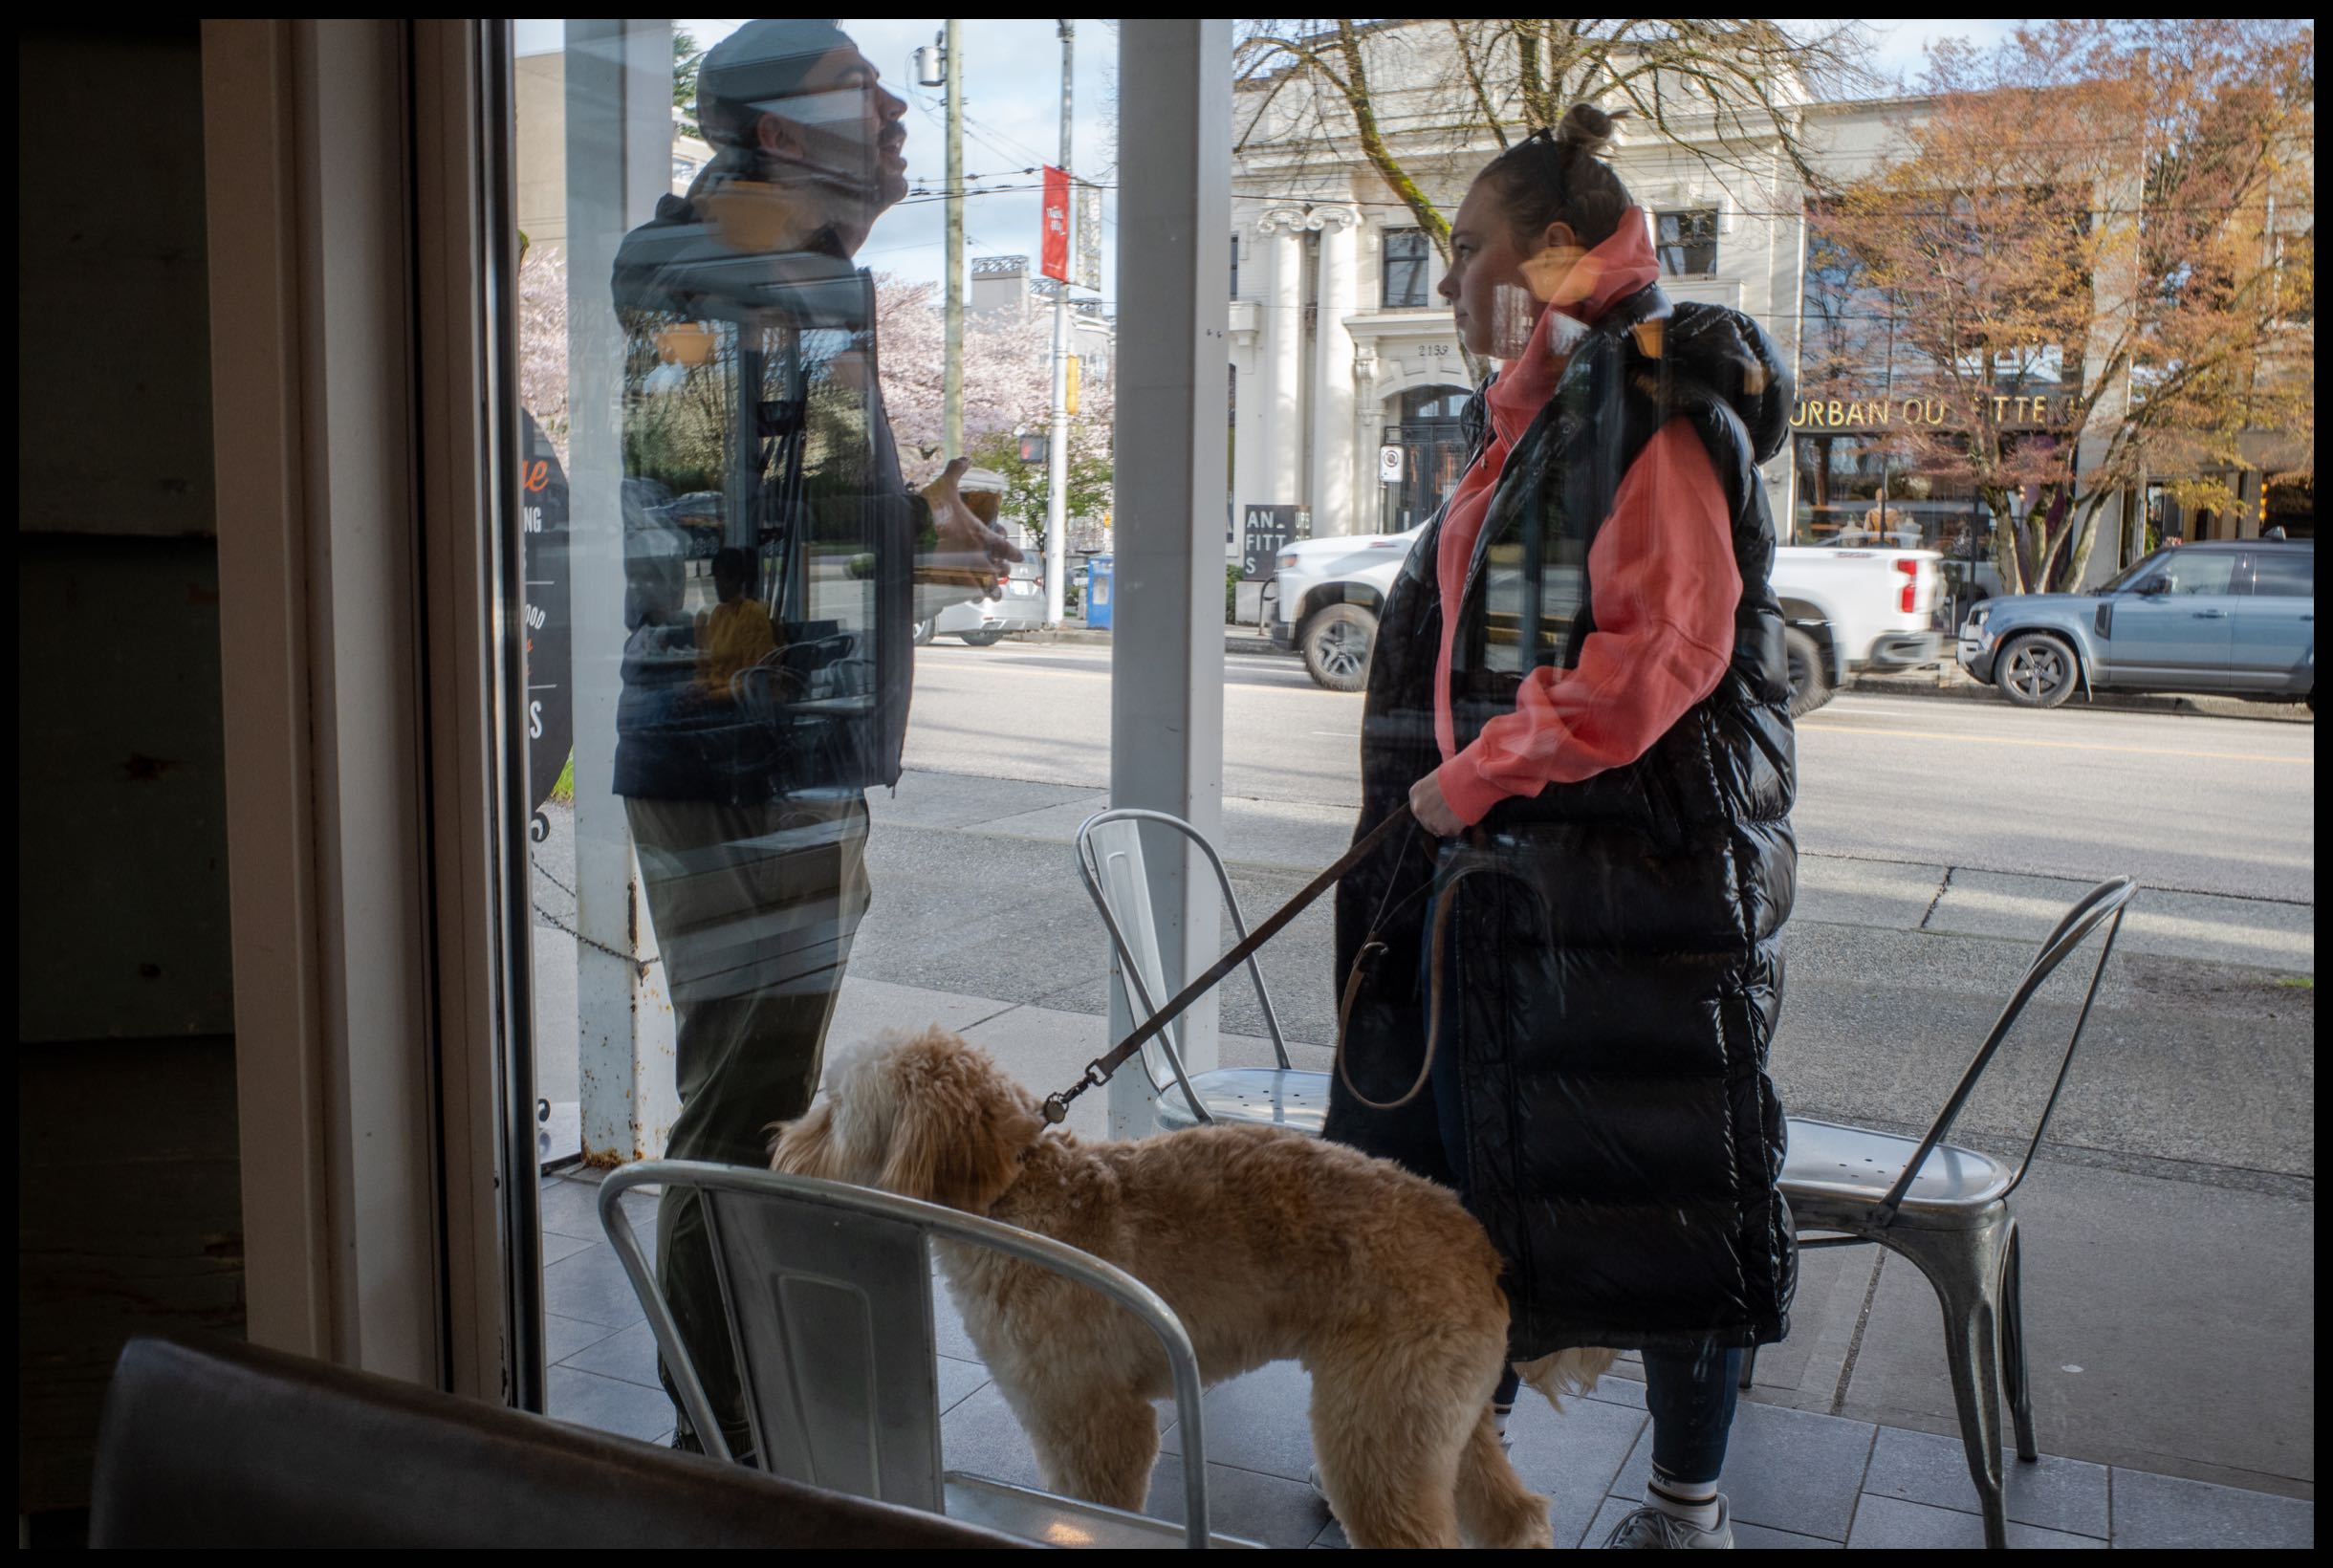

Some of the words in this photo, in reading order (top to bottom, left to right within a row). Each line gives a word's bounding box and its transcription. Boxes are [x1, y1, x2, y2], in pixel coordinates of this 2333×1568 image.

[1789, 398, 1889, 426] URBAN
[1245, 534, 1287, 552] FITT
[1245, 556, 1256, 575] S
